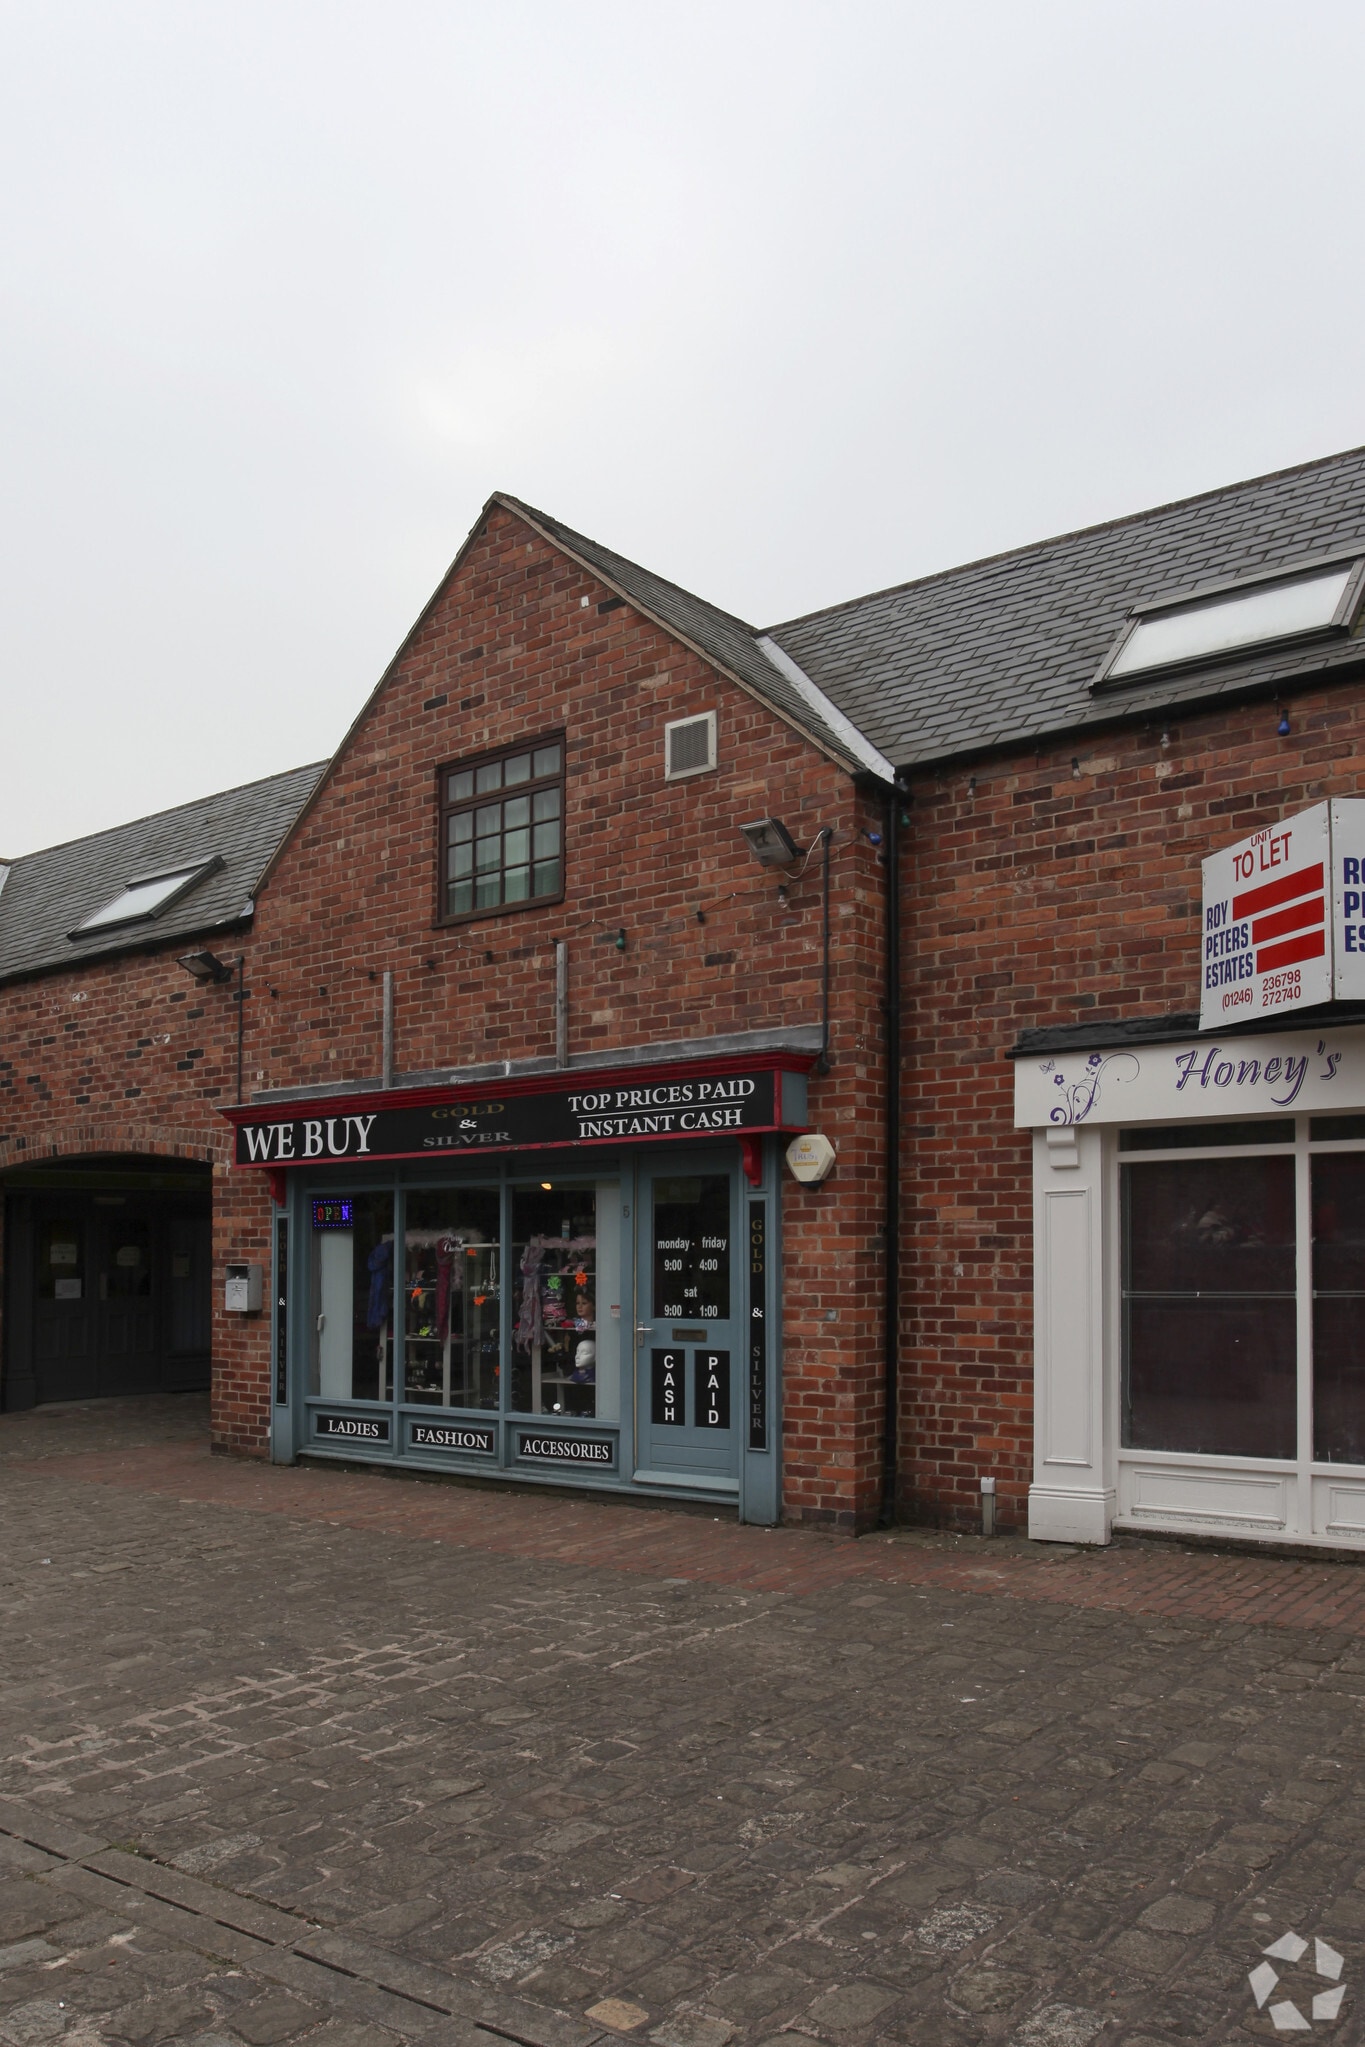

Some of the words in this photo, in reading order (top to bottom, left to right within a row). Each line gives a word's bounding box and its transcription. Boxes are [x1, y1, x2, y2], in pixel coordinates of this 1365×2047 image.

[1250, 828, 1273, 847] UNIT
[1233, 850, 1254, 882] TO
[1260, 831, 1292, 871] LET
[1343, 857, 1365, 885] R
[1206, 900, 1228, 931] ROY
[1344, 891, 1365, 919] P
[1206, 923, 1249, 960] PETERS
[1205, 952, 1253, 989] ESTATES
[1262, 969, 1301, 991] 236798
[1222, 988, 1253, 1012] (01246)
[1262, 985, 1301, 1007] 272740
[1175, 1040, 1342, 1106] Honey's
[568, 1093, 611, 1112] TOP
[615, 1084, 694, 1106] PRICES
[698, 1079, 755, 1100] PAID
[431, 1103, 505, 1119] GOLD
[459, 1119, 477, 1129] &
[578, 1114, 675, 1138] INSTANT
[680, 1108, 743, 1129] CASH
[243, 1123, 295, 1161] WE
[302, 1115, 377, 1158] BUY
[422, 1131, 512, 1147] SILVER
[317, 1205, 349, 1221] OPEN
[622, 1205, 630, 1219] 5
[657, 1237, 690, 1251] monday
[701, 1236, 727, 1250] friday
[752, 1219, 763, 1274] GOLD
[664, 1259, 682, 1271] 9:00
[699, 1259, 718, 1271] 4:00
[278, 1298, 286, 1306] &
[684, 1286, 698, 1298] sat
[664, 1305, 682, 1317] 9:00
[699, 1305, 718, 1317] 1:00
[752, 1307, 763, 1318] &
[663, 1355, 675, 1422] CASH
[707, 1357, 719, 1424] PAID
[752, 1346, 763, 1429] SILVER
[328, 1419, 379, 1437] LADIES
[416, 1428, 489, 1449] FASHION
[523, 1439, 610, 1460] ACCESSORIES
